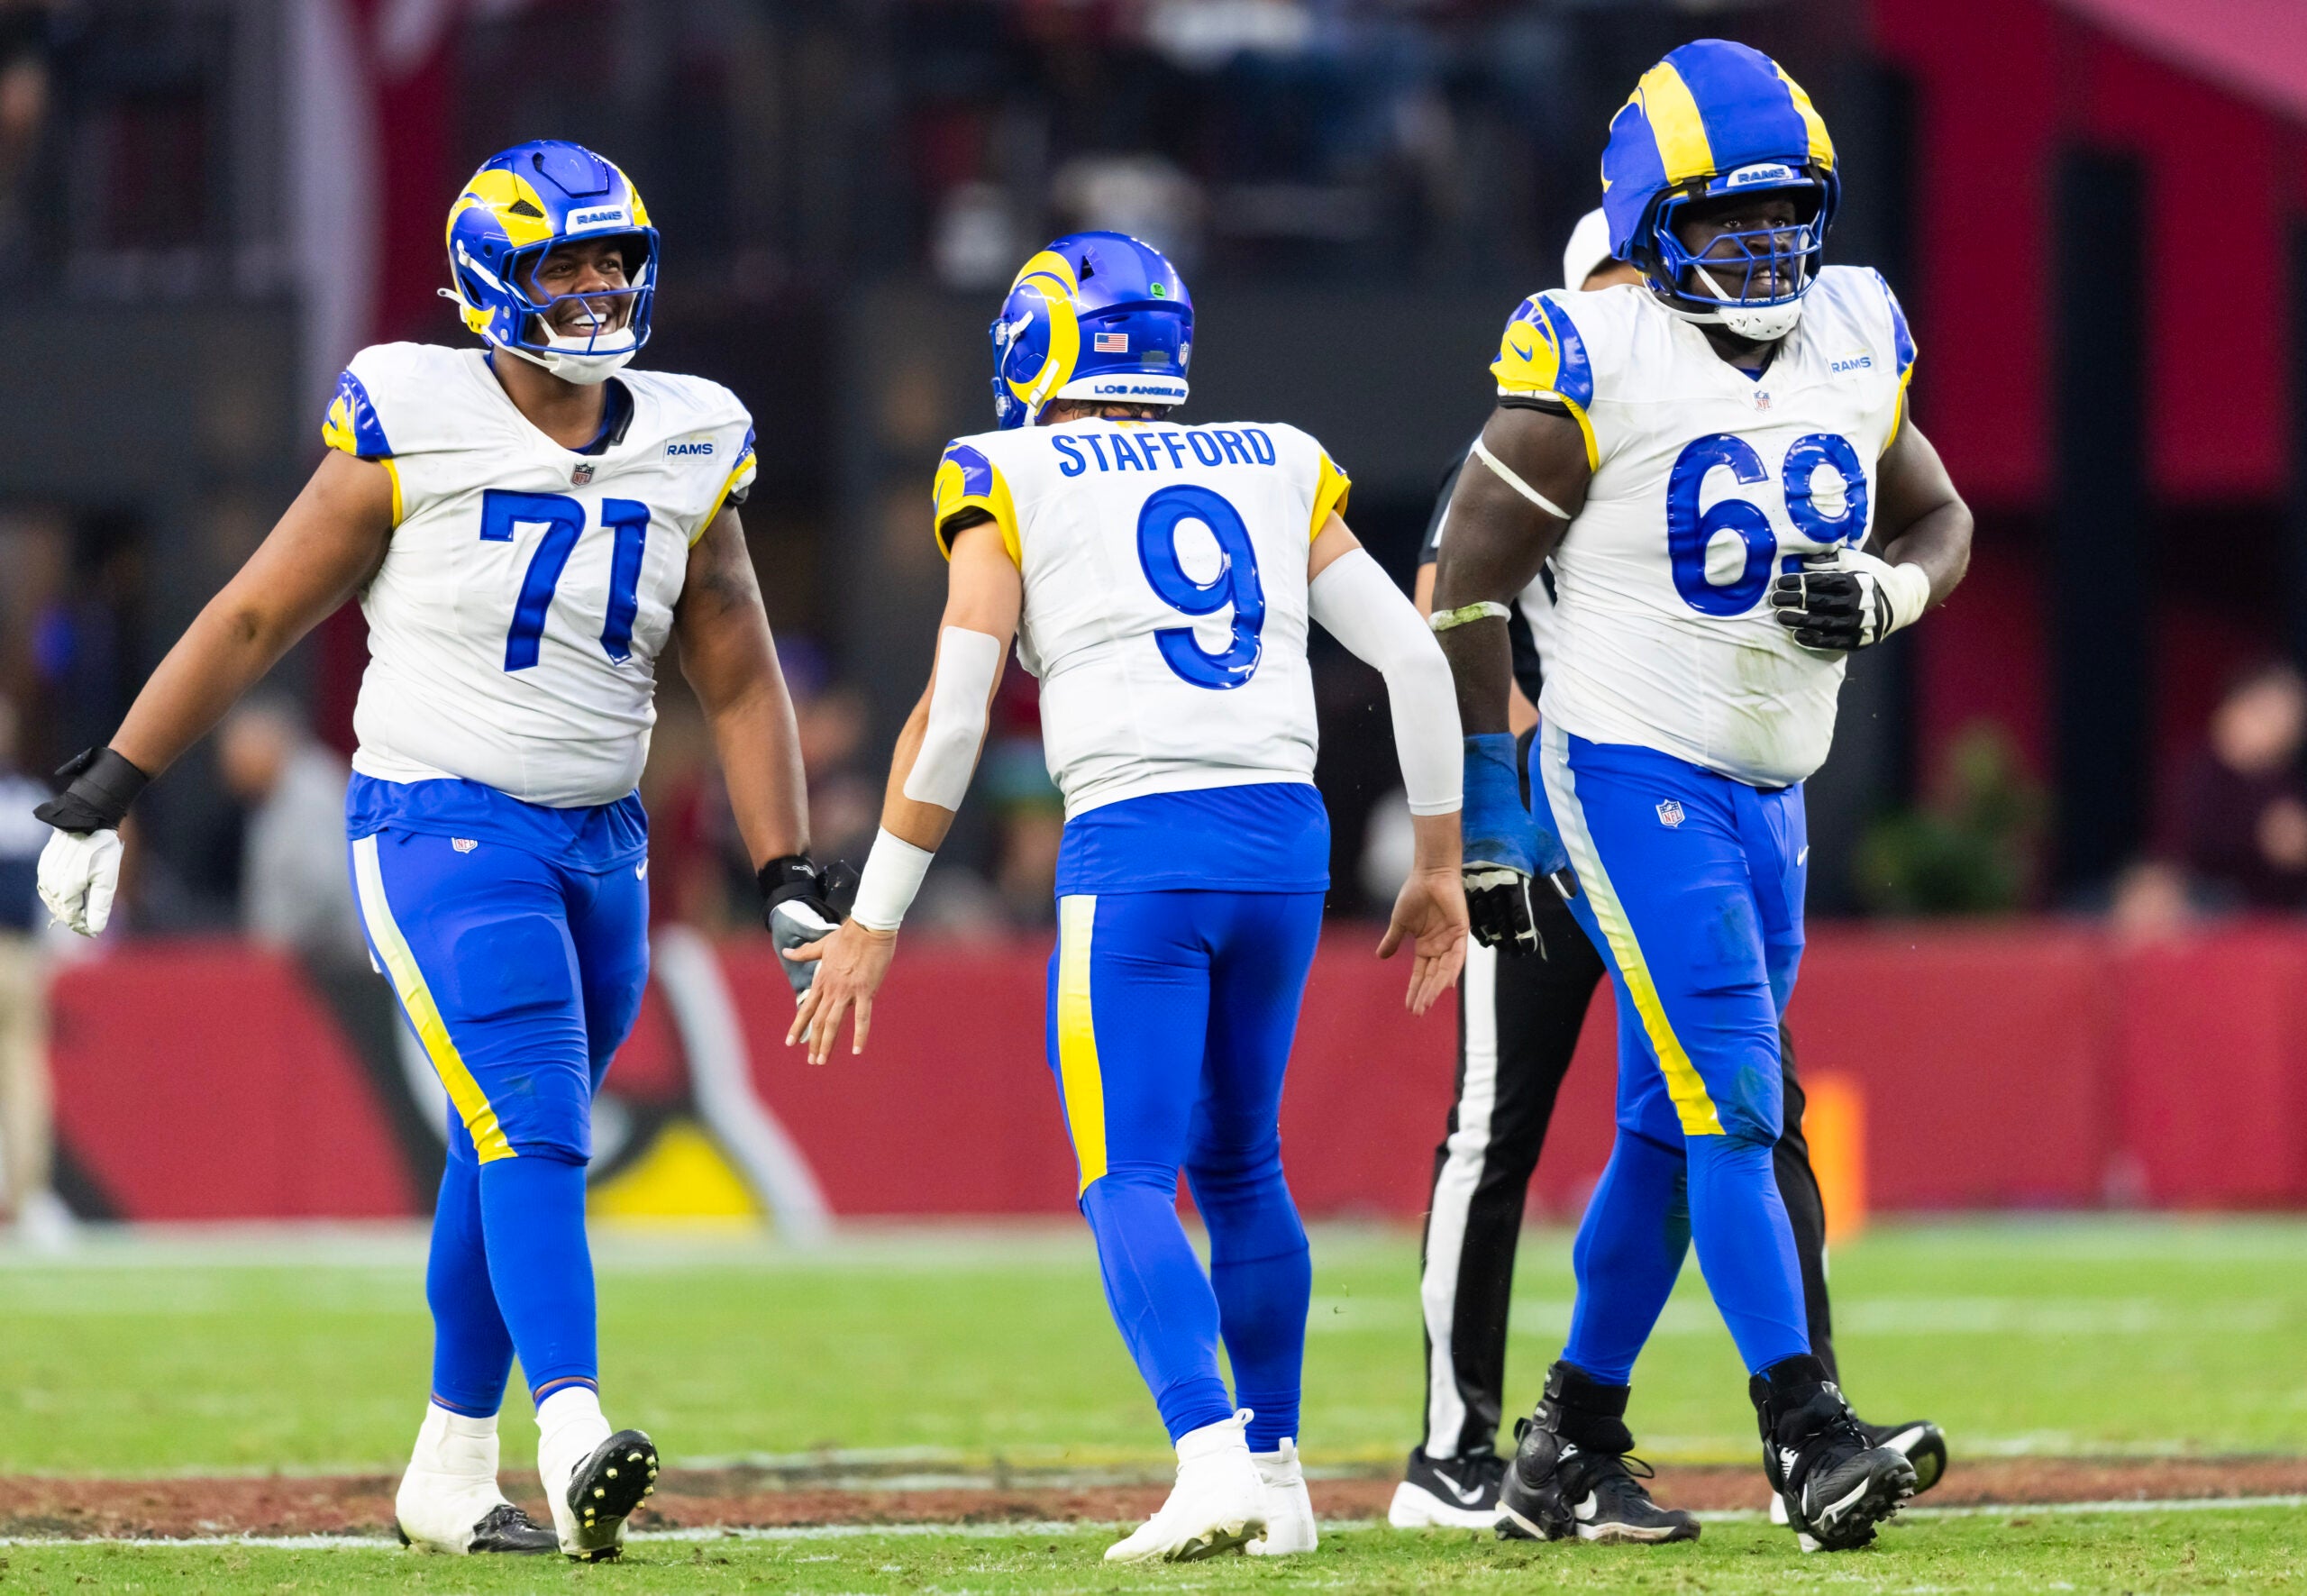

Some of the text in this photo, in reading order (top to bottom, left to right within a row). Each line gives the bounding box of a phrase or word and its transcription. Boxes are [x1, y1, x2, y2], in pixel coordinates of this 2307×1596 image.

[1737, 168, 1785, 183] RAMS
[577, 211, 622, 224] RAMS
[1831, 356, 1872, 373] RAMS
[1094, 385, 1127, 394] LOS
[667, 443, 714, 455] RAMS
[1052, 428, 1276, 478] STAFFORD
[1666, 433, 1868, 616] 69
[479, 488, 651, 672] 71
[1136, 484, 1265, 690] 9
